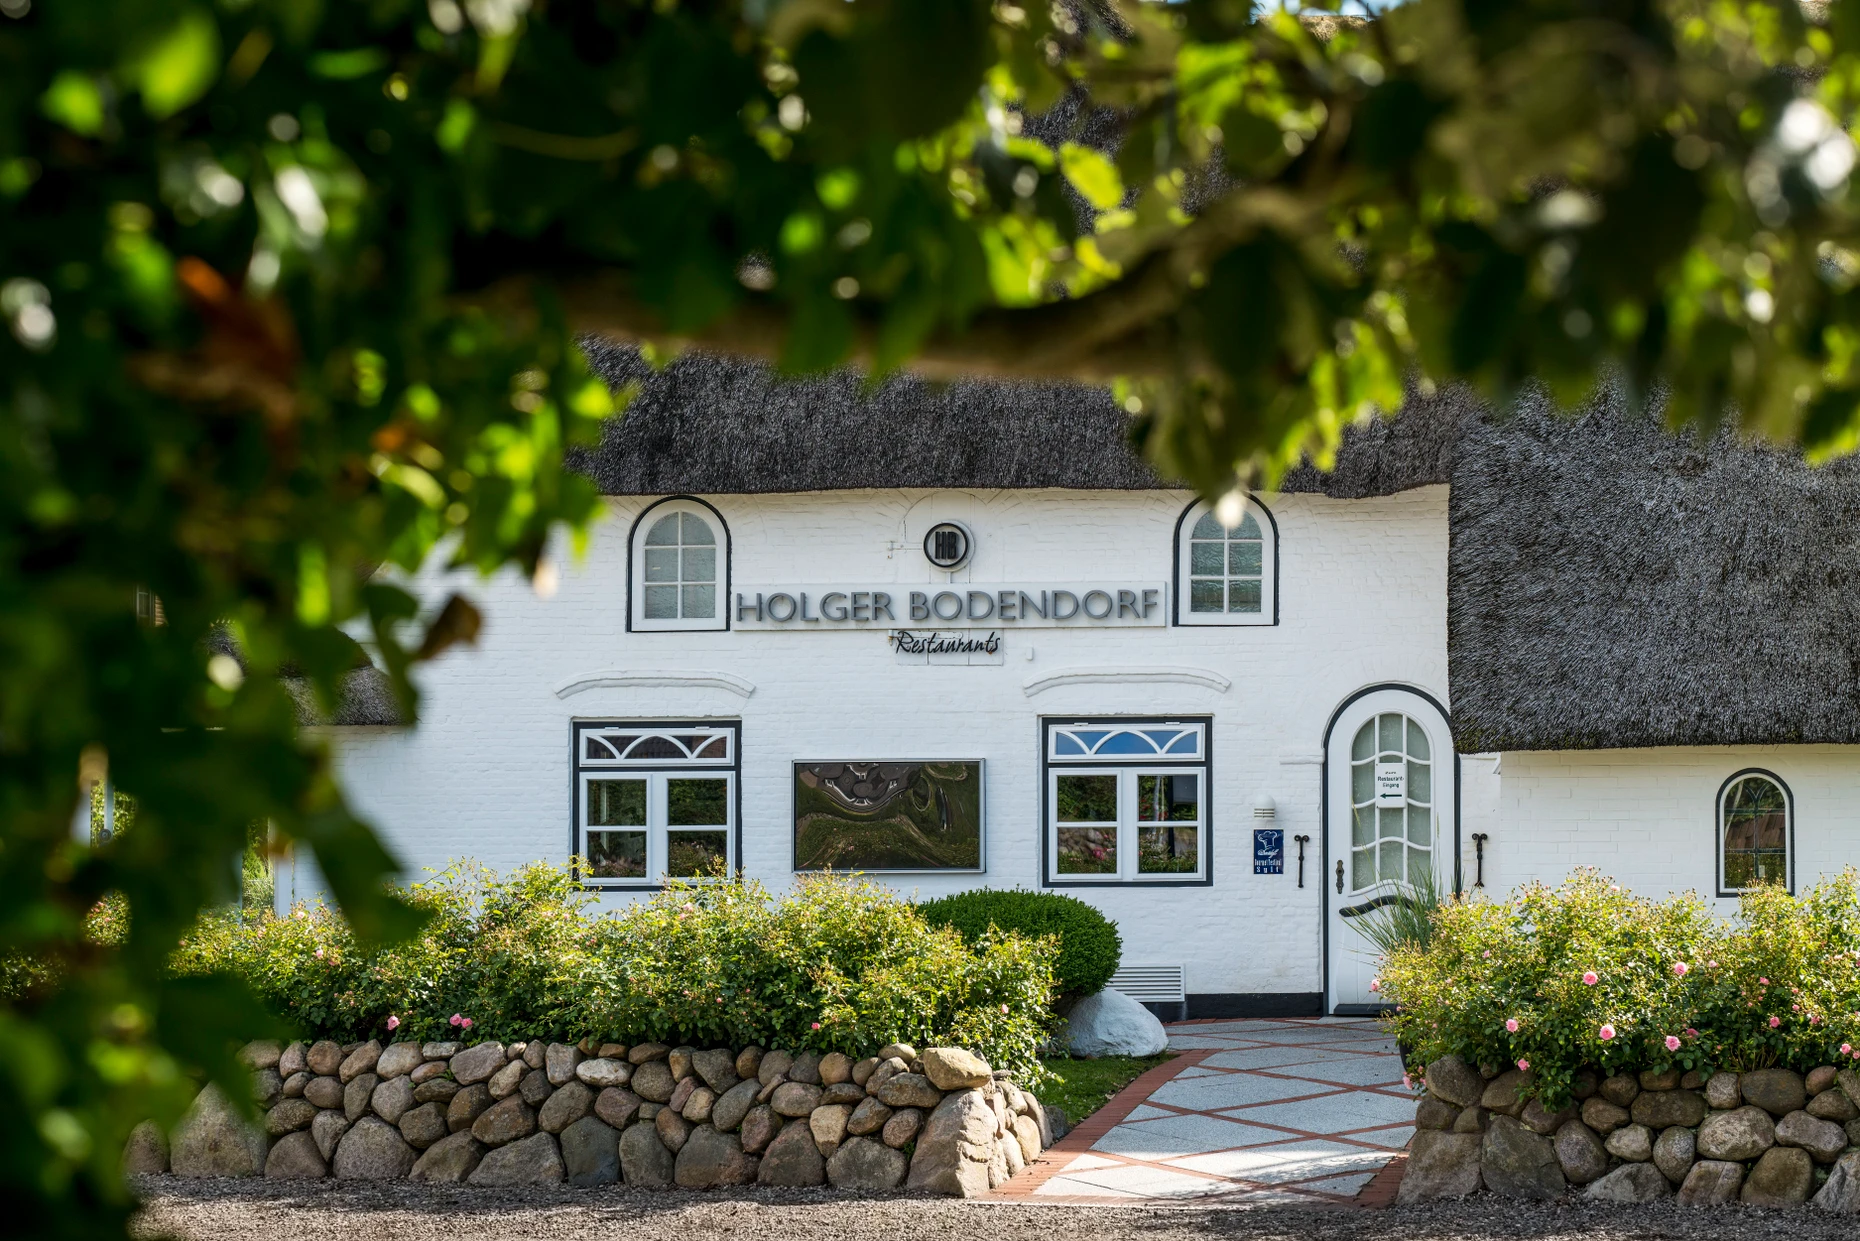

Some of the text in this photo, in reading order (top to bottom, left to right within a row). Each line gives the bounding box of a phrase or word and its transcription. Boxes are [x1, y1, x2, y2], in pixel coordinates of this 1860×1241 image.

[736, 589, 1159, 622] HOLGER BODENDORF
[896, 631, 1001, 655] Restaurants
